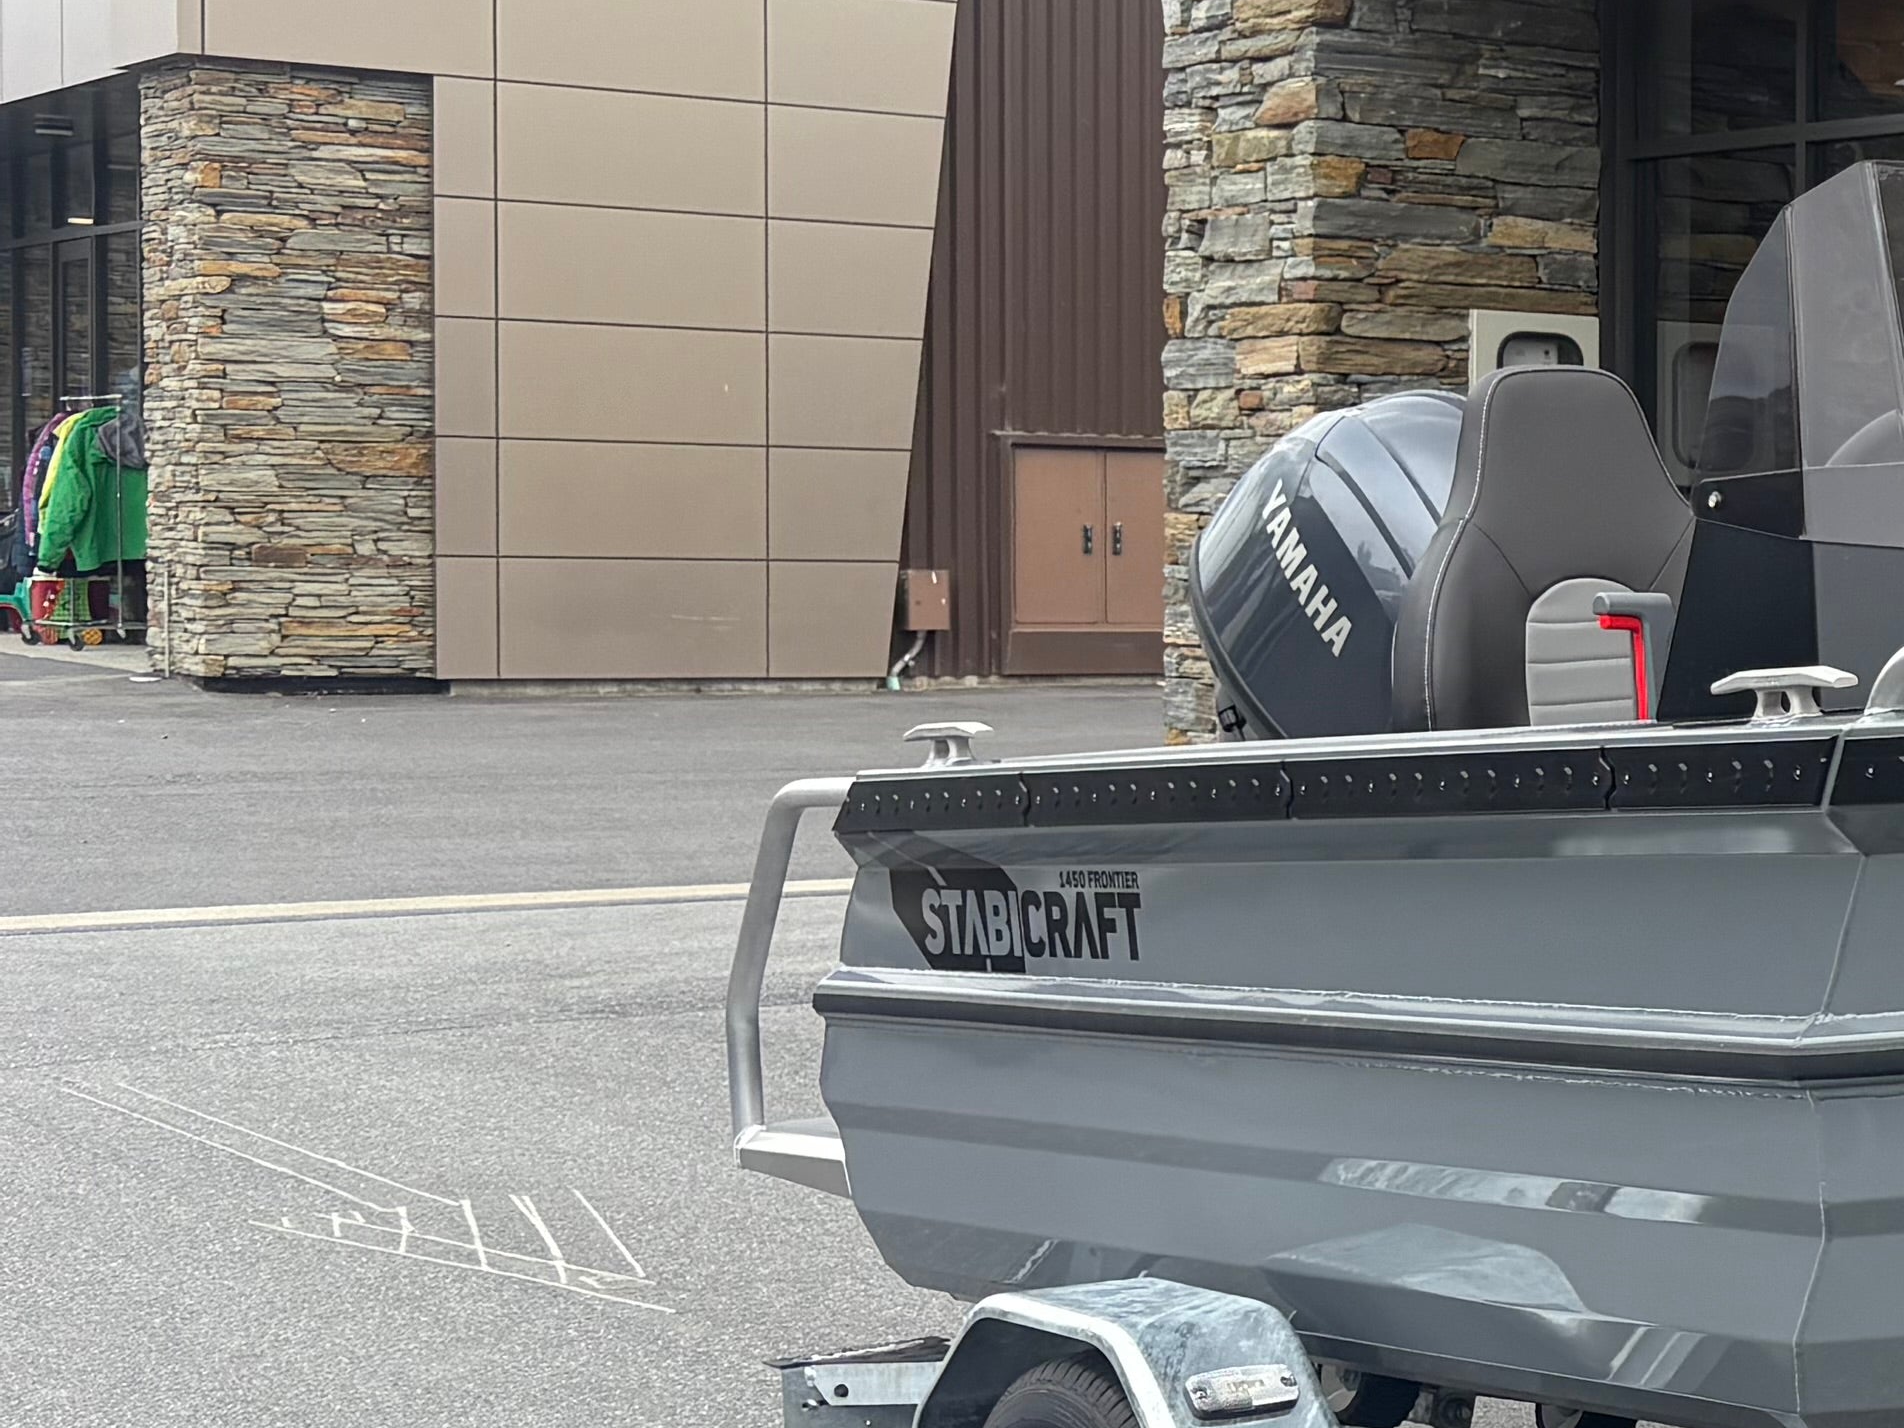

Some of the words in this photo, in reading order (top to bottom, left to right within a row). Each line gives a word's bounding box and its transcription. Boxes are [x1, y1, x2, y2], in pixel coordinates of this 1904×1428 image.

[1261, 478, 1354, 658] YAMAHA
[1059, 870, 1087, 889] 1450
[1087, 870, 1140, 890] FRONTIER
[920, 887, 1142, 961] STABICRAFT
